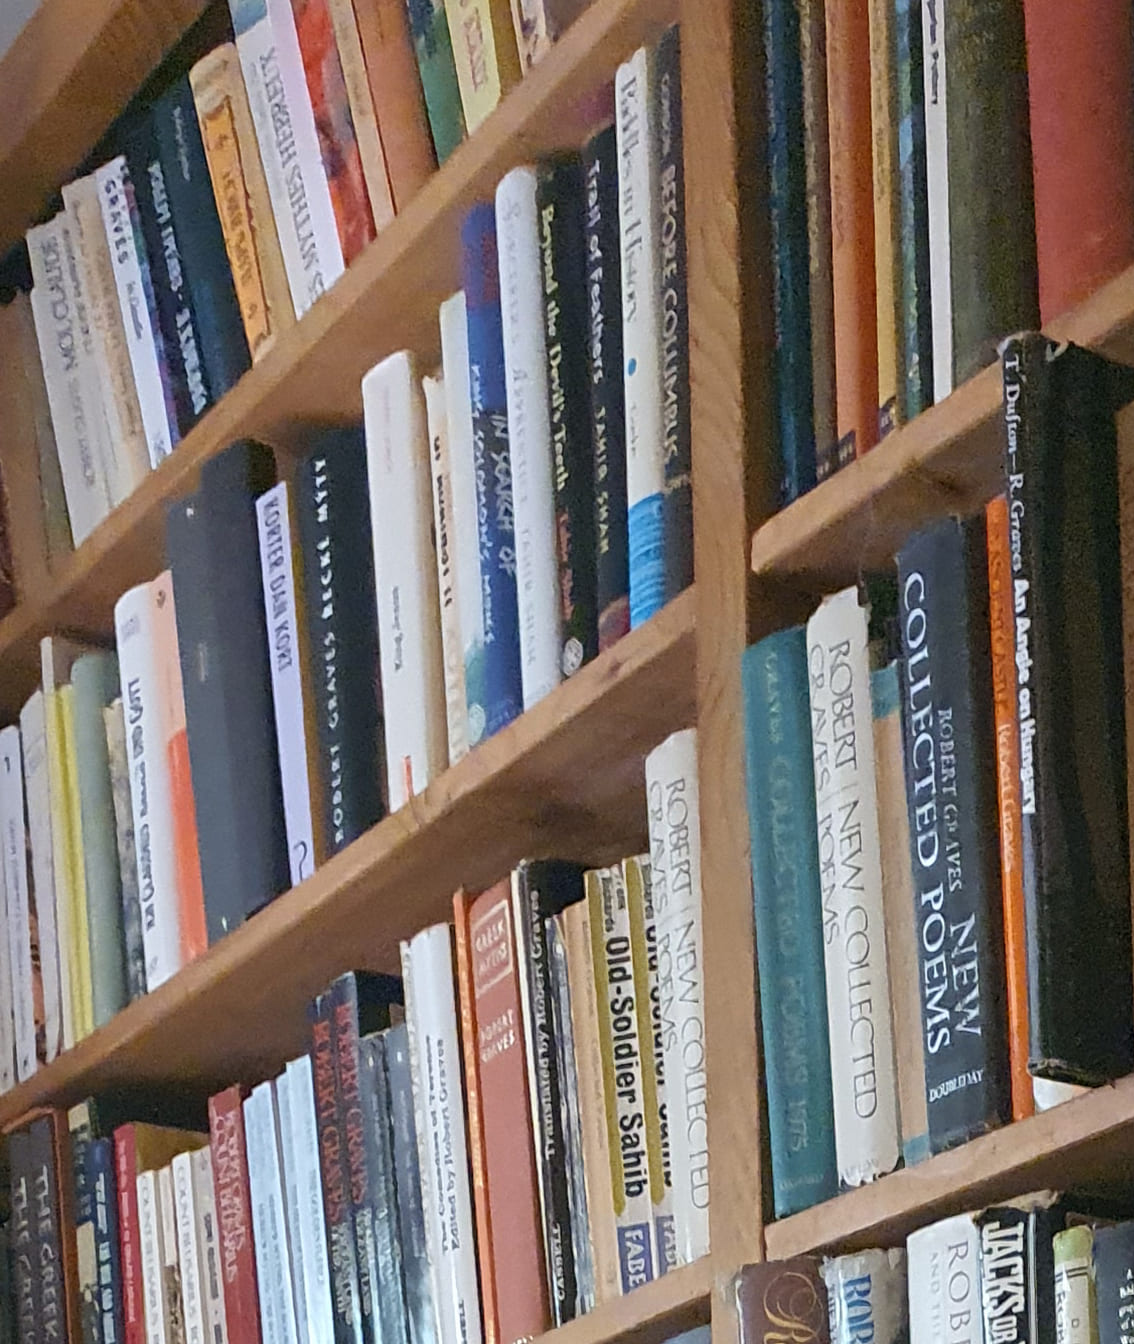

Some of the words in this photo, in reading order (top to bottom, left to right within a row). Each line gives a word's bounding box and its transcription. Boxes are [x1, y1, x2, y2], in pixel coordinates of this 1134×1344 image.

[661, 164, 676, 276] BEFORE
[810, 645, 830, 788] GRAVES
[827, 640, 858, 769] ROBERT
[901, 570, 940, 868] COLLECTED
[940, 707, 958, 798] ROBERT
[665, 778, 691, 896] ROBERT
[818, 812, 842, 945] POEMS
[837, 800, 864, 893] NEW
[943, 804, 963, 893] GRAVES
[606, 936, 637, 1105] Old-Soldier
[675, 920, 699, 1004] NEW
[842, 907, 878, 1119] COLLECTED
[920, 880, 950, 1055] POEMS
[950, 912, 982, 1036] NEW
[680, 1017, 711, 1209] COLLECTED
[929, 1069, 984, 1104] DOUBLEDAY
[619, 1113, 644, 1198] Sahib
[623, 1230, 648, 1292] FABE
